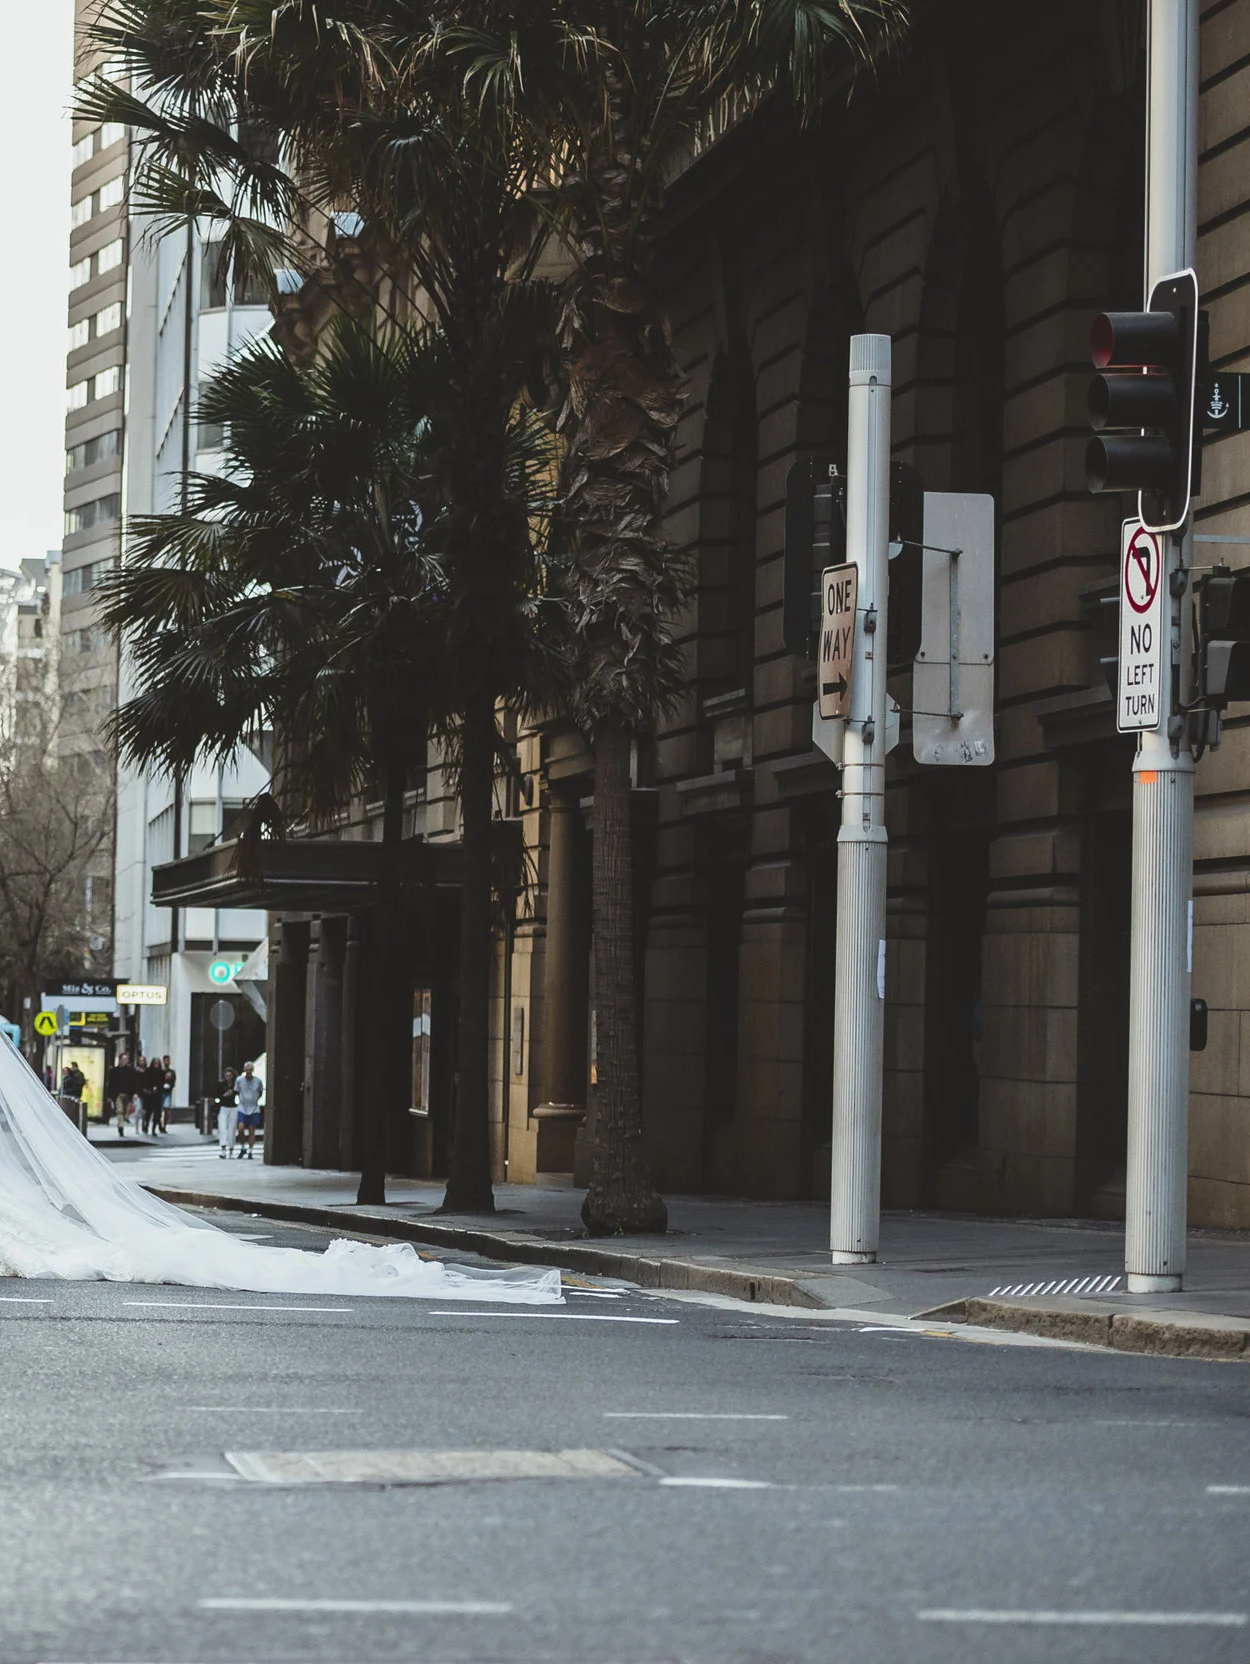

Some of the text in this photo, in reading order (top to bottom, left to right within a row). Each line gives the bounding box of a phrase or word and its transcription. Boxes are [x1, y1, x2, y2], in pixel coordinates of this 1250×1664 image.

[828, 580, 851, 616] ONE
[823, 627, 850, 662] WAY
[1131, 623, 1152, 655] NO
[1127, 664, 1154, 686] LEFT
[1126, 694, 1154, 716] TURN
[81, 983, 94, 995] &
[122, 991, 162, 1000] OPTUS
